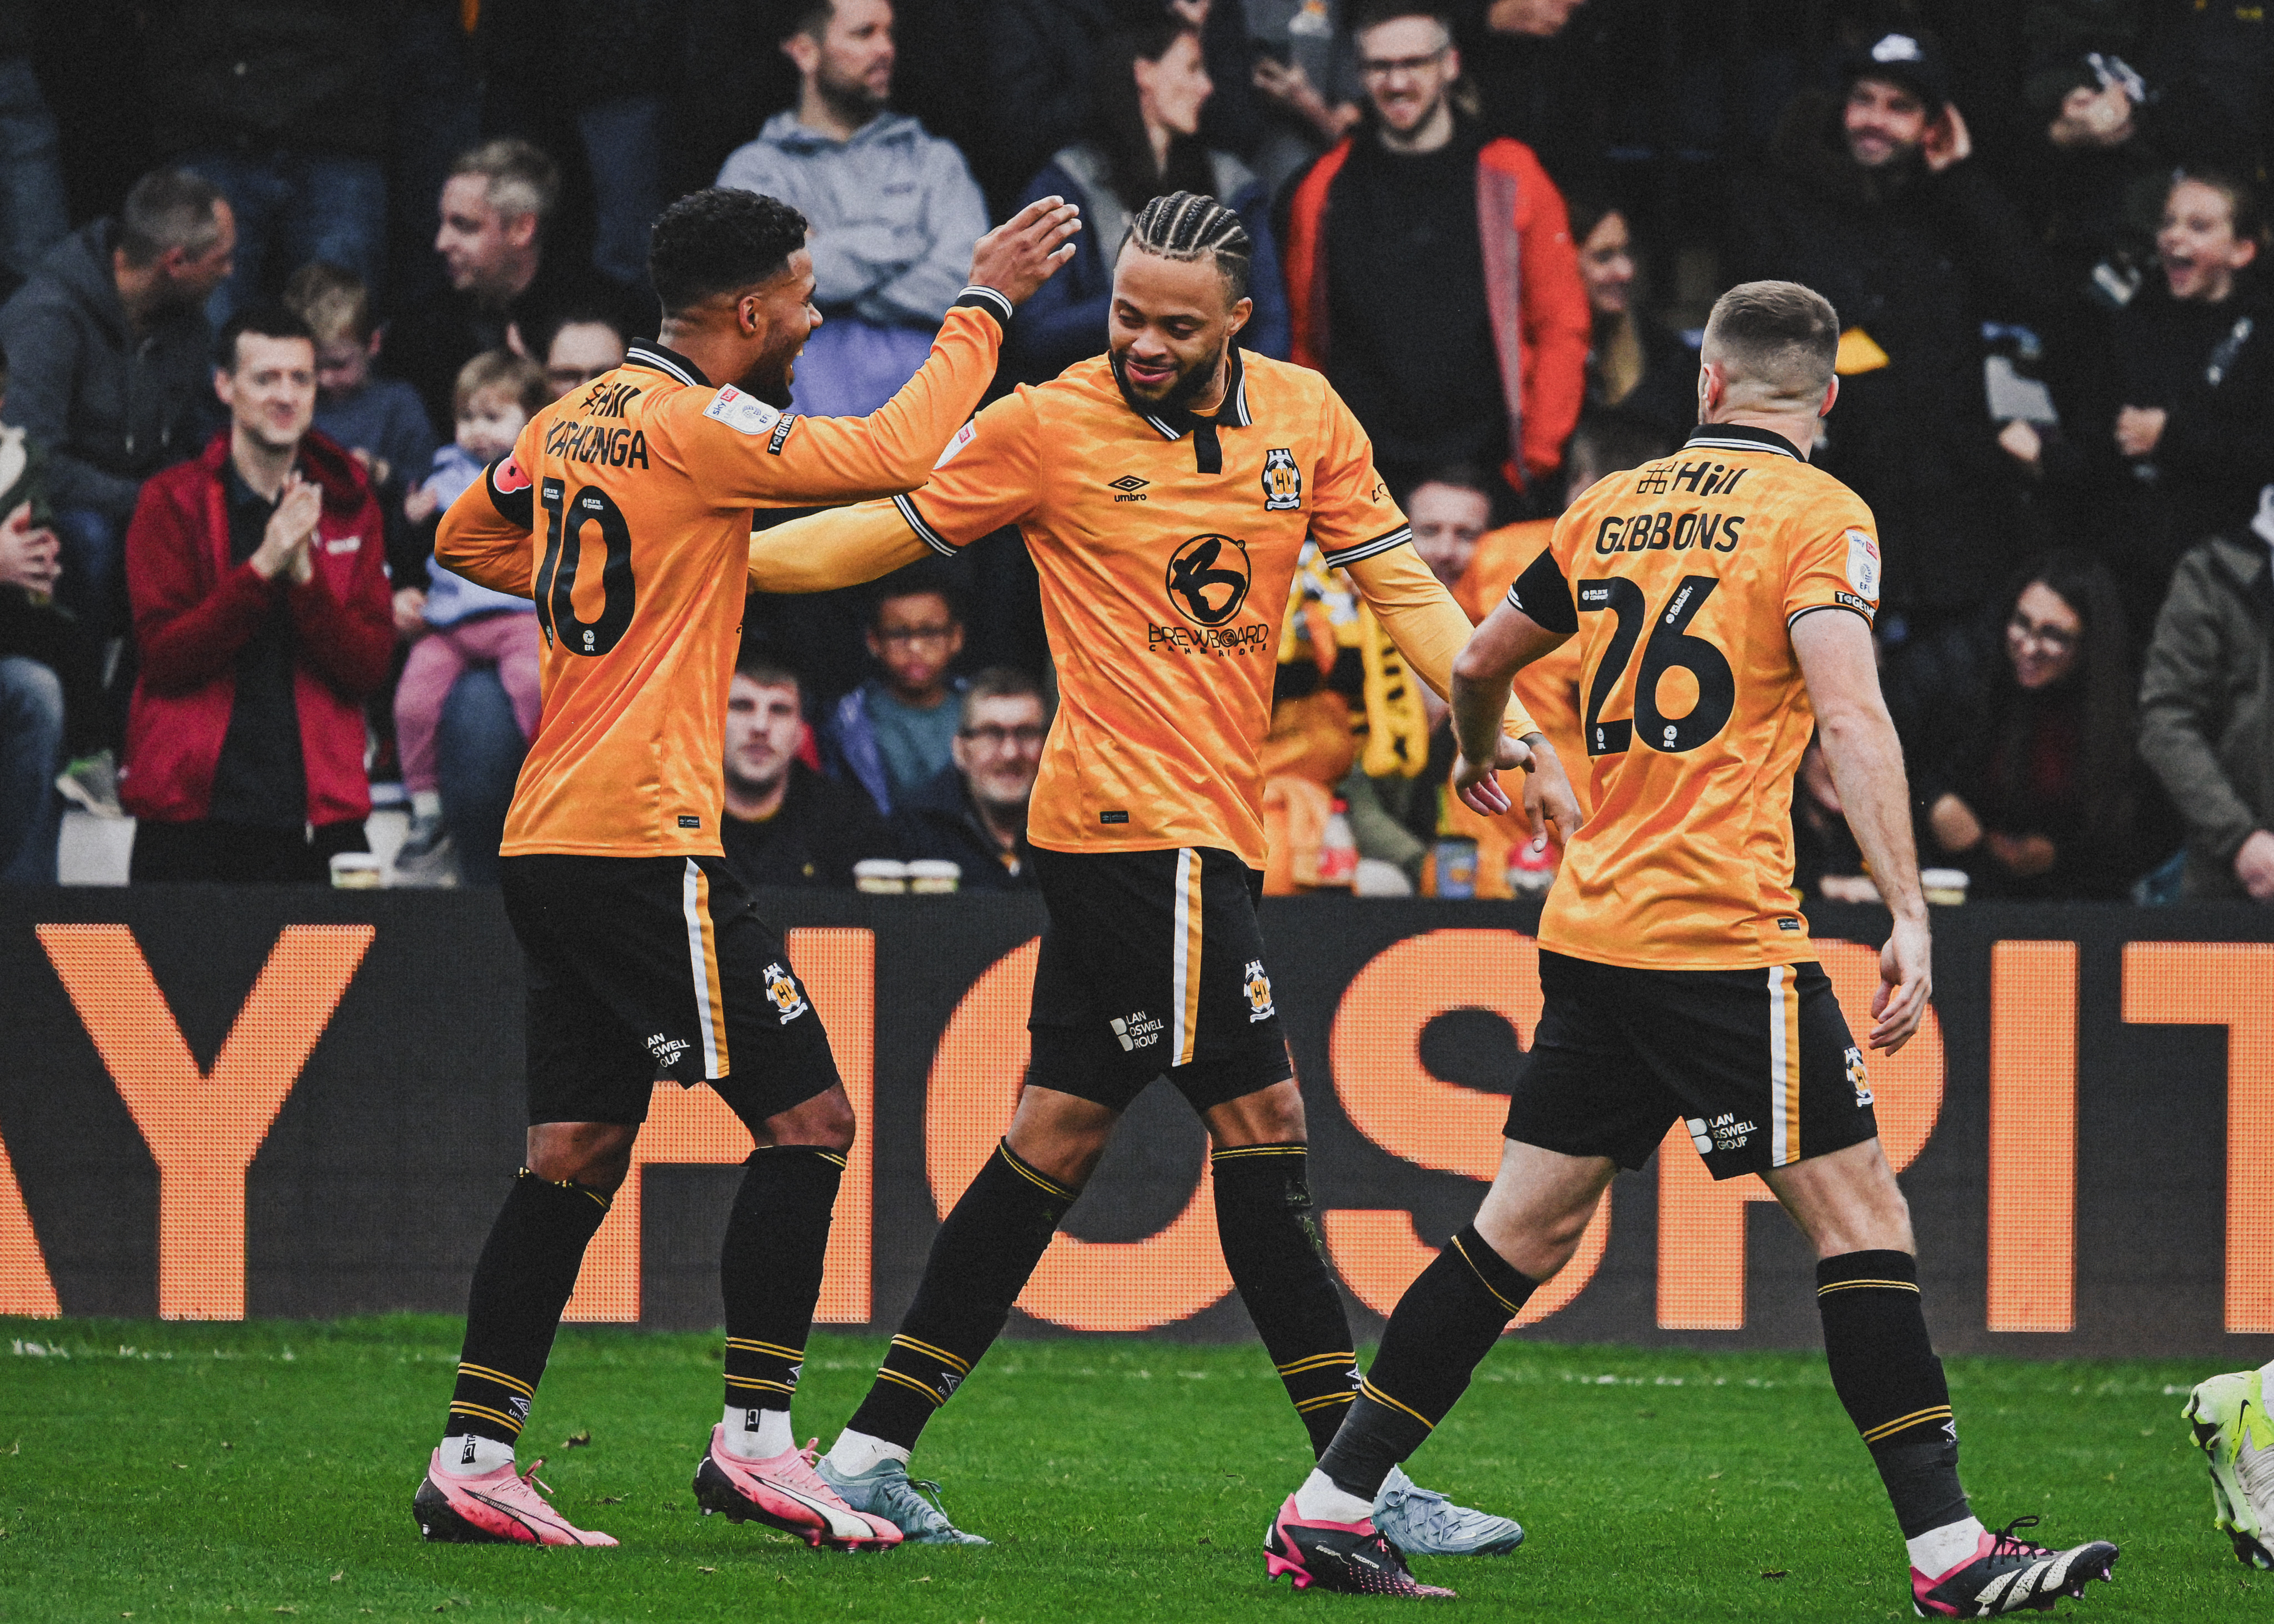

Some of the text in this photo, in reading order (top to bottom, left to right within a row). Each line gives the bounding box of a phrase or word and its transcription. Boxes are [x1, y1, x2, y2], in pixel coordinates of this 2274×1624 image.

[1671, 461, 1749, 496] Hill
[1114, 492, 1147, 502] umbro
[1595, 511, 1745, 555] GIBBONS
[534, 476, 636, 657] 10
[1860, 582, 1871, 594] EFL
[1148, 622, 1269, 648] BREWBOARD
[1148, 643, 1267, 657] CAMBRIDGE
[1577, 575, 1736, 757] 26
[1351, 1552, 1380, 1570] PREDATOR
